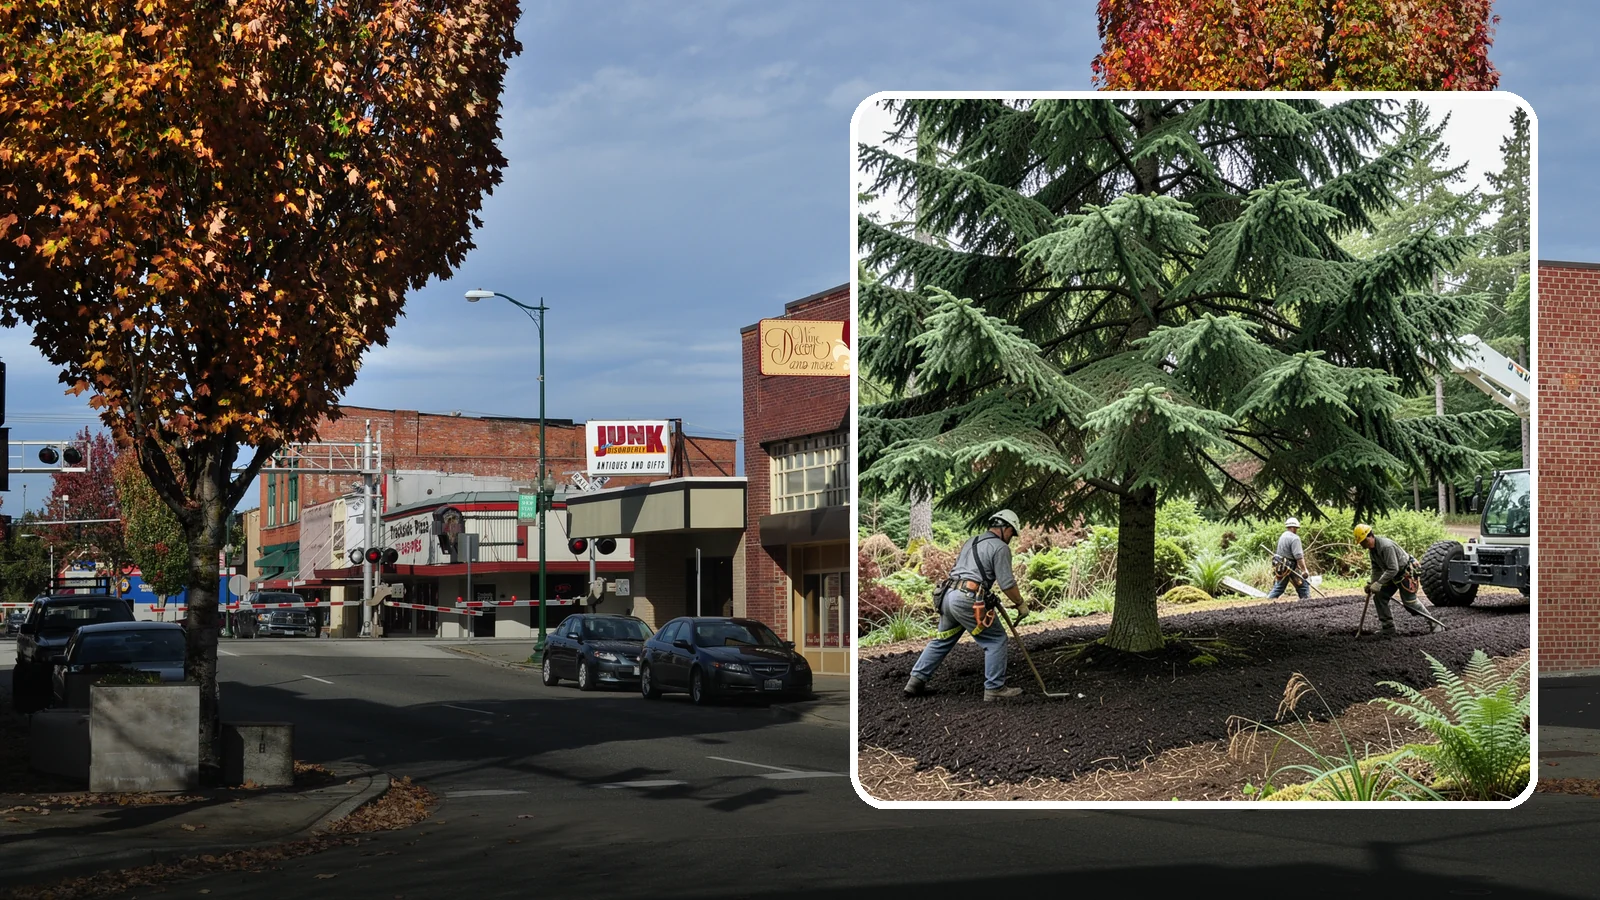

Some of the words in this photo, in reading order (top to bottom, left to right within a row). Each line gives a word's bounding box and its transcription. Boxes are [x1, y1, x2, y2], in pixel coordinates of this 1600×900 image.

[596, 425, 665, 457] JUNK
[597, 461, 628, 470] ANTIQUES
[631, 461, 643, 470] AND
[647, 460, 665, 469] GIFTS
[352, 498, 365, 511] CRO
[390, 521, 413, 539] Trackside
[415, 519, 429, 535] Pizza
